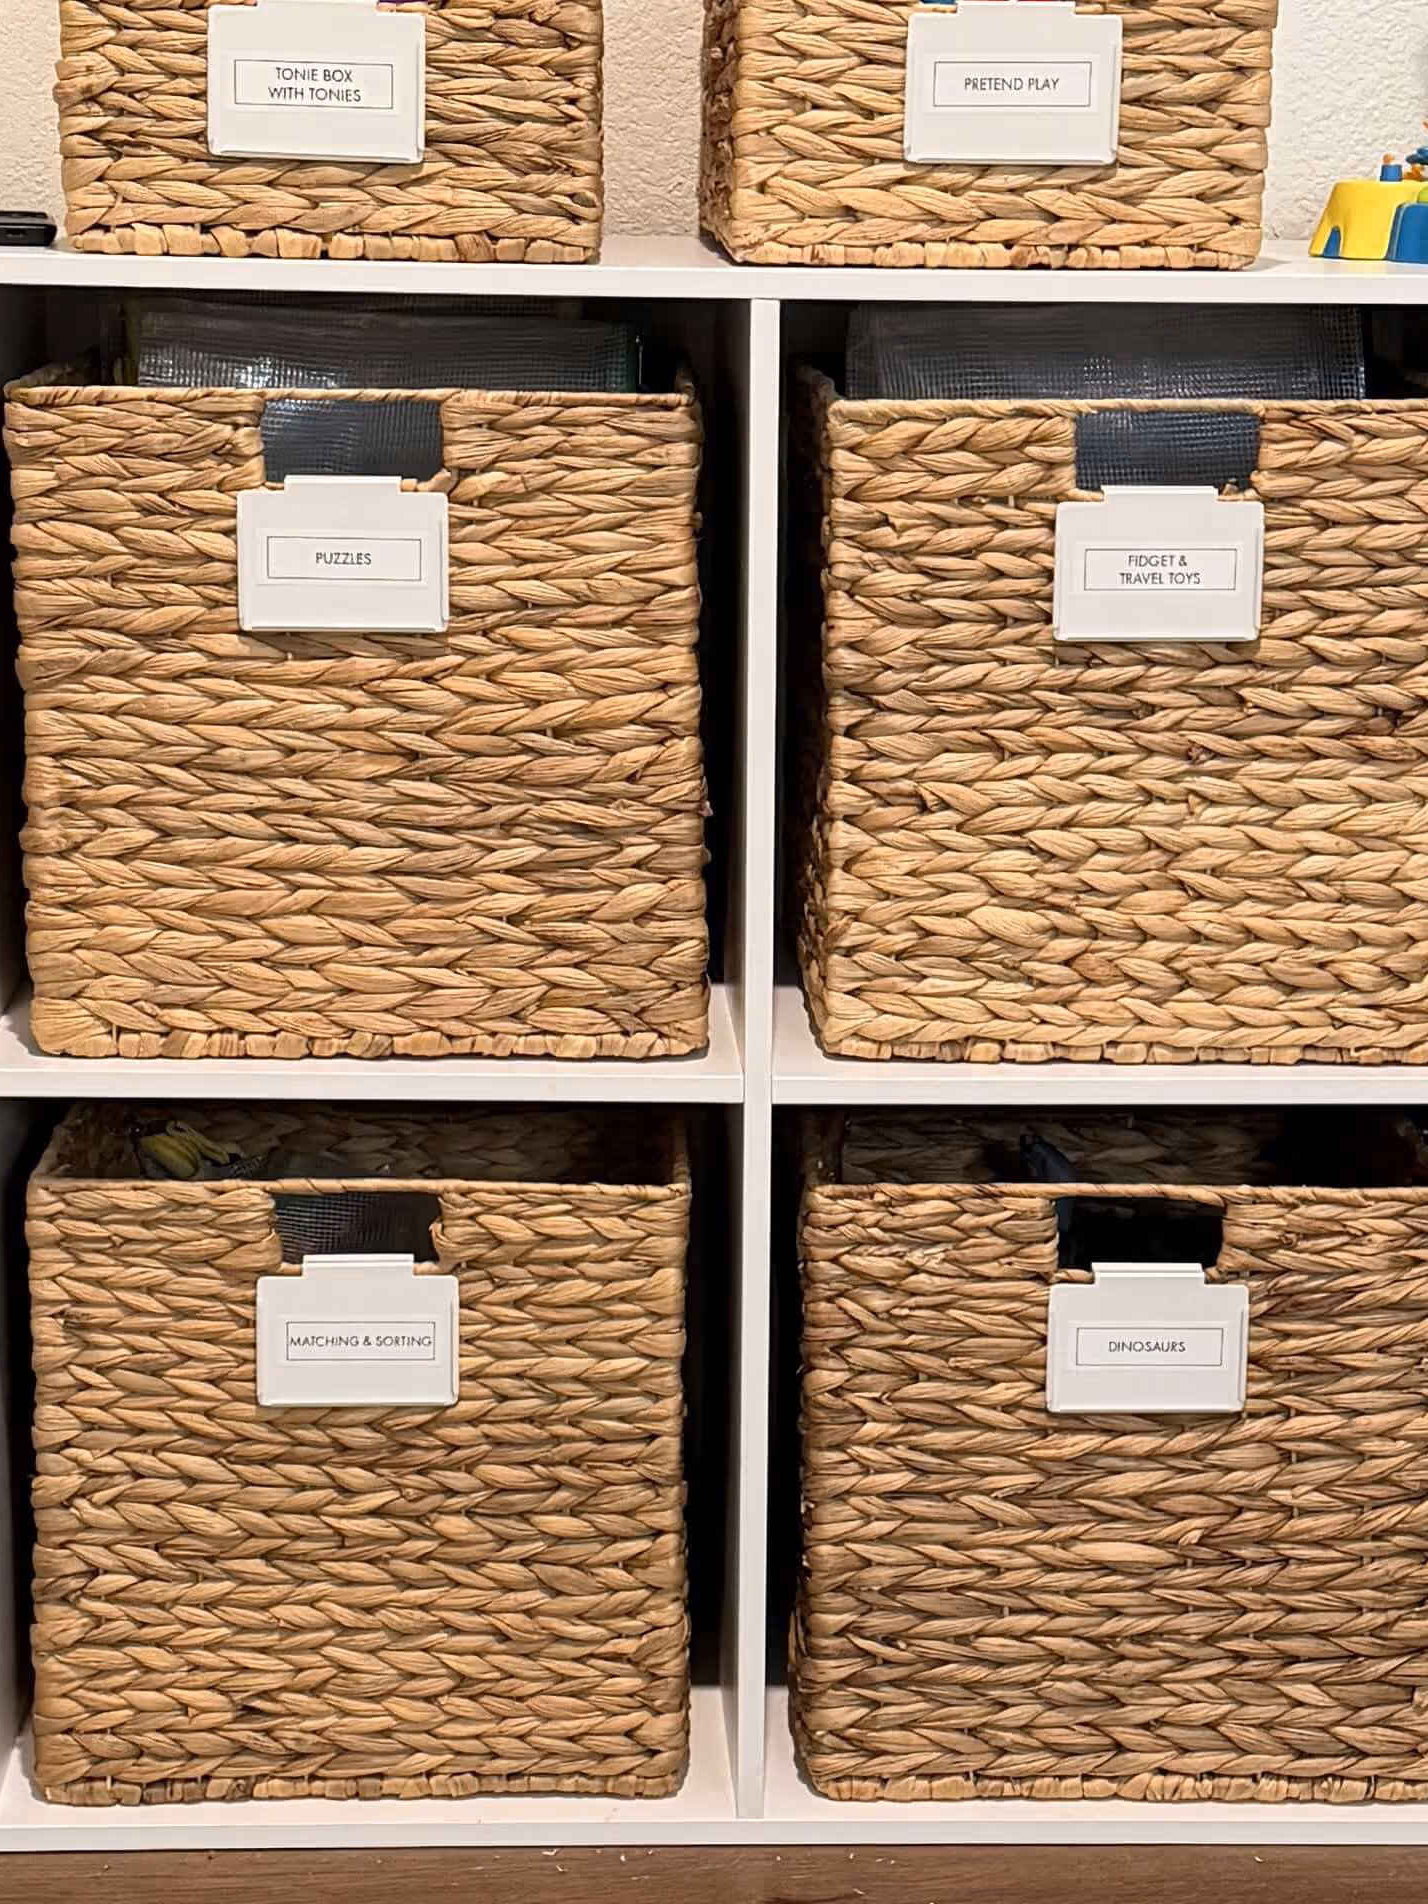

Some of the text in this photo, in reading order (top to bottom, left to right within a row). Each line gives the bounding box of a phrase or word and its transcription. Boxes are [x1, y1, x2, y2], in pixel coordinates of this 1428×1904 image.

[276, 67, 353, 82] TONIE BOX
[964, 77, 1060, 91] PRETEND PLAY
[268, 86, 362, 102] WITH TONIES
[315, 551, 372, 566] PUZZLES
[1128, 555, 1188, 567] FIDGET &
[1119, 572, 1201, 585] TRAVEL TOYS
[290, 1335, 432, 1347] MATCHING & SORTING
[1108, 1340, 1187, 1353] DINOSAURS
